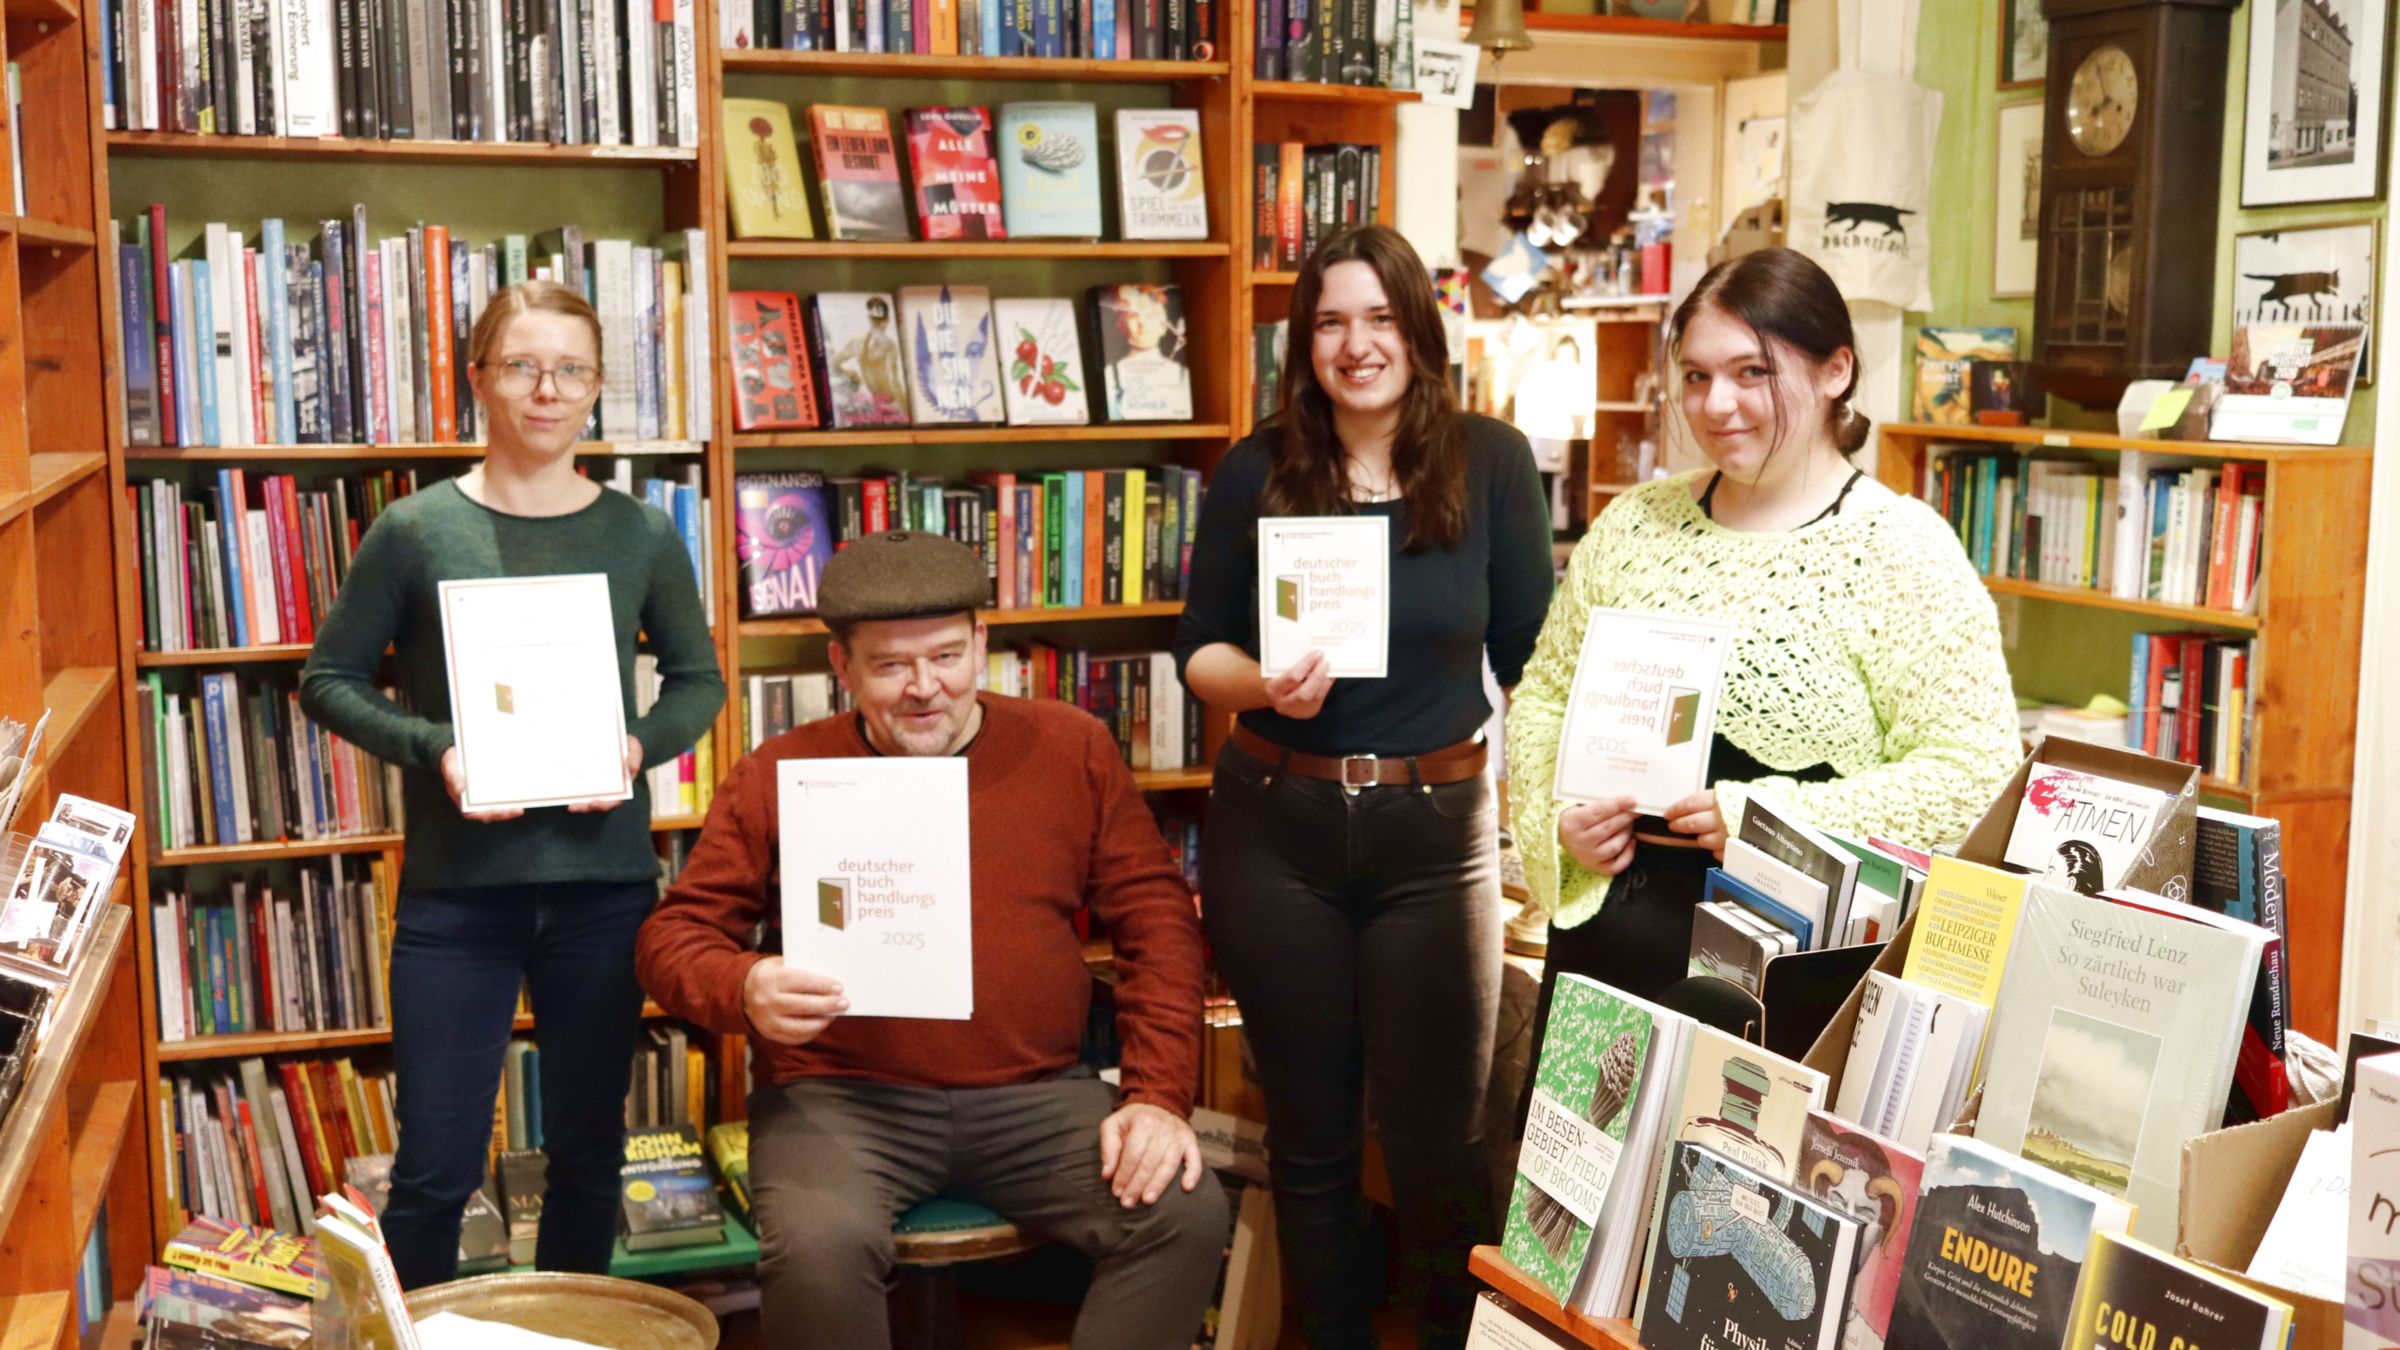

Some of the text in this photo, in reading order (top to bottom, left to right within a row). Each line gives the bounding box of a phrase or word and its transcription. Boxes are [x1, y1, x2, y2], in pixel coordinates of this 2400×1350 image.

[237, 6, 251, 62] DENKMAL
[287, 11, 299, 81] Erinnerung
[580, 18, 595, 102] Young at Heart
[937, 139, 973, 152] ALLE
[934, 170, 988, 184] MEINE
[743, 187, 802, 209] WIND
[931, 200, 998, 216] MÜTTER
[1129, 196, 1168, 212] SPIEL
[1130, 212, 1202, 228] TROMMELN
[1286, 241, 1297, 262] DER
[933, 302, 960, 324] DIE
[755, 300, 800, 421] BABY
[795, 357, 806, 380] VON
[941, 358, 971, 380] SIN
[936, 386, 972, 409] NEN
[737, 475, 823, 488] POZNANSKI
[1293, 557, 1359, 570] deutscher
[1309, 571, 1342, 583] buch
[1309, 585, 1376, 600] handlungs
[1309, 600, 1342, 613] preis
[1328, 621, 1366, 636] 2025
[1751, 814, 1777, 838] Gaetano
[2054, 799, 2147, 845] ATMEN
[837, 857, 915, 874] deutscher
[857, 875, 895, 889] buch
[857, 891, 937, 909] handlungs
[1986, 887, 2008, 903] Wieser
[857, 906, 896, 921] preis
[881, 931, 926, 950] 2025
[1939, 917, 1998, 948] LEIPZIGER
[2068, 918, 2189, 966] Siegfried Lenz
[1925, 931, 1993, 964] BUCHMESSE
[2057, 945, 2187, 996] So zärtlich war
[2077, 976, 2152, 1013] Suleyken
[2268, 949, 2284, 1051] Neue Rundschau
[2368, 1086, 2399, 1106] Theater
[1529, 1099, 1589, 1149] IM BESEN-
[624, 1142, 704, 1162] RISHAM
[628, 1131, 683, 1151] JOHN
[1722, 1141, 1768, 1172] Paul Divjak
[1533, 1156, 1600, 1216] OF BROOMS
[1966, 1193, 2031, 1234] Alex Hutchinson
[1939, 1225, 2039, 1299] ENDURE
[1923, 1272, 1946, 1289] Grenzen
[1945, 1280, 1957, 1293] der
[1955, 1285, 1989, 1309] menschlichen
[1946, 1269, 1962, 1284] Geist
[1961, 1277, 1973, 1289] und
[1972, 1281, 1982, 1292] die
[2163, 1289, 2226, 1323] Josef Rohrer
[2094, 1302, 2157, 1350] COLD
